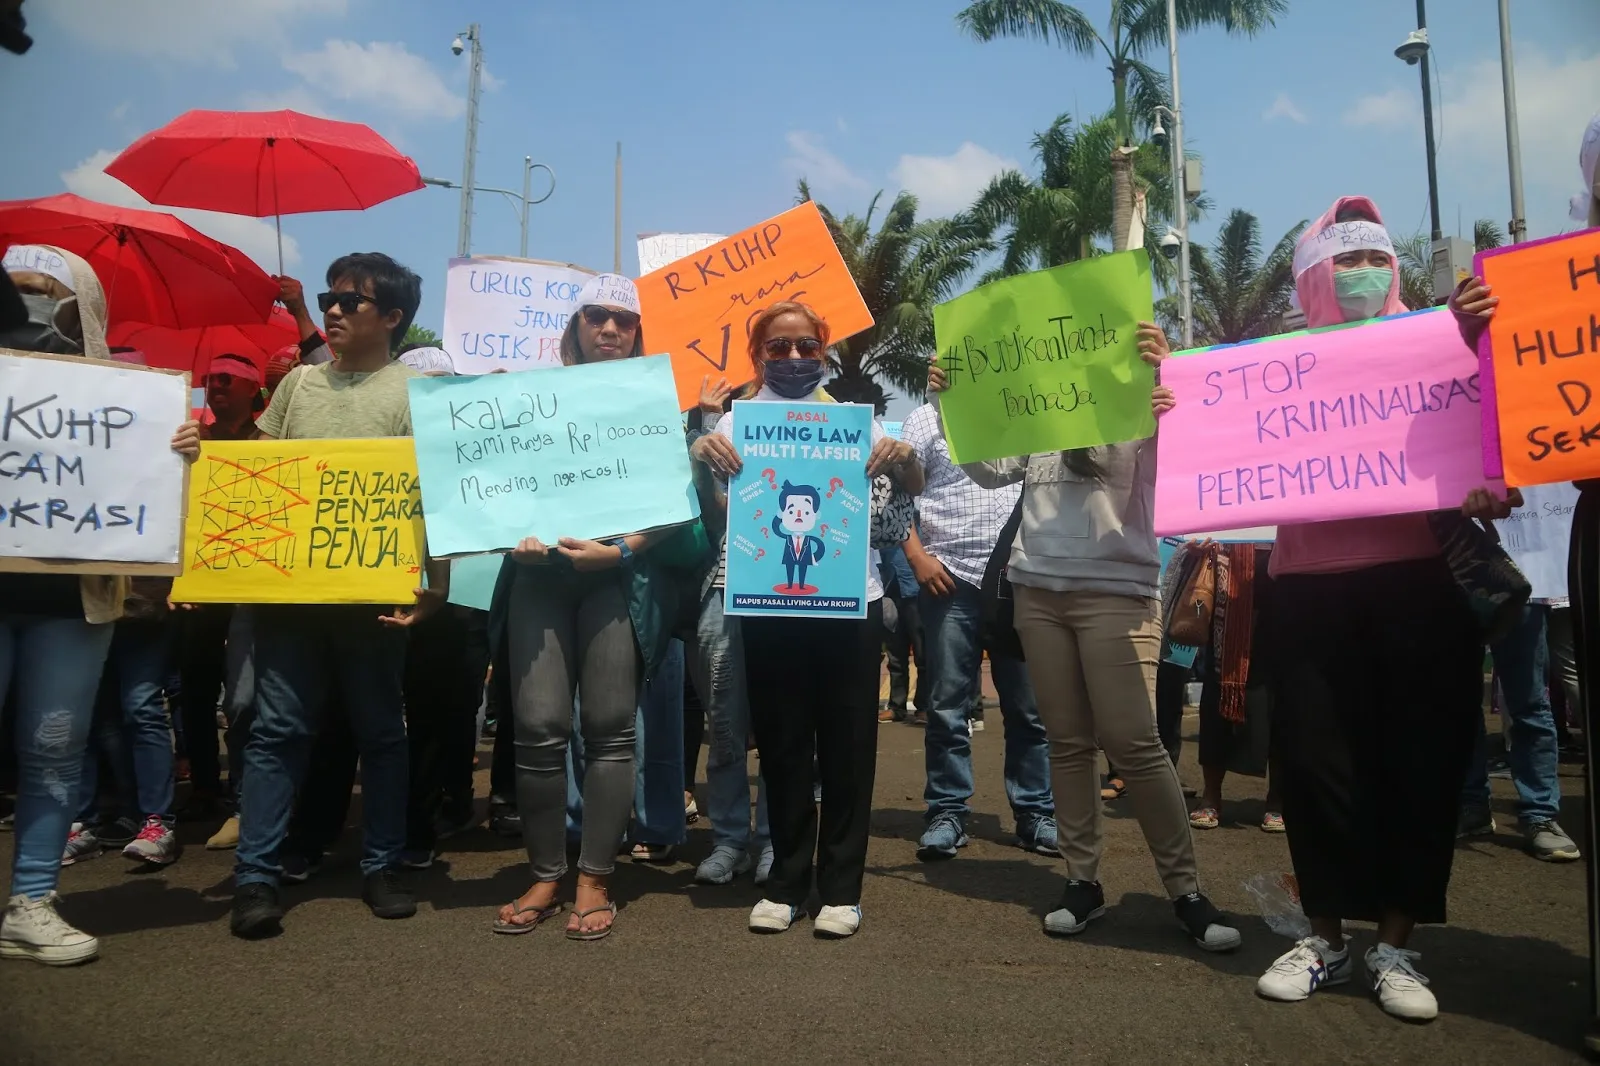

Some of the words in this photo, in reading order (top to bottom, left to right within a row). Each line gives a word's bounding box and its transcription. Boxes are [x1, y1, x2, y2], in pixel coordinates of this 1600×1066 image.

[1312, 222, 1373, 244] TUNDA
[470, 270, 533, 298] URUS
[545, 280, 583, 301] KOR
[599, 275, 637, 296] TUNDA
[716, 263, 826, 322] rasa
[1203, 352, 1316, 407] STOP
[3, 394, 137, 449] KUHP
[787, 411, 829, 423] PASAL
[744, 425, 812, 442] LIVING
[818, 428, 862, 444] LAW
[743, 443, 796, 459] MULTI
[801, 445, 861, 461] TAFSIR
[460, 475, 538, 504] Mending
[738, 480, 763, 496] HUKUM
[1198, 450, 1408, 510] PEREMPUAN
[840, 488, 864, 508] HUKUM
[841, 499, 860, 514] ADAT
[200, 500, 290, 532] KERJA
[316, 498, 425, 524] PENJARA
[732, 541, 753, 556] AGAMA
[736, 534, 756, 551] HUKUM
[736, 597, 761, 605] HAPUS
[762, 598, 786, 606] PASAL
[787, 599, 812, 607] LIVING
[830, 600, 857, 608] RKUHP
